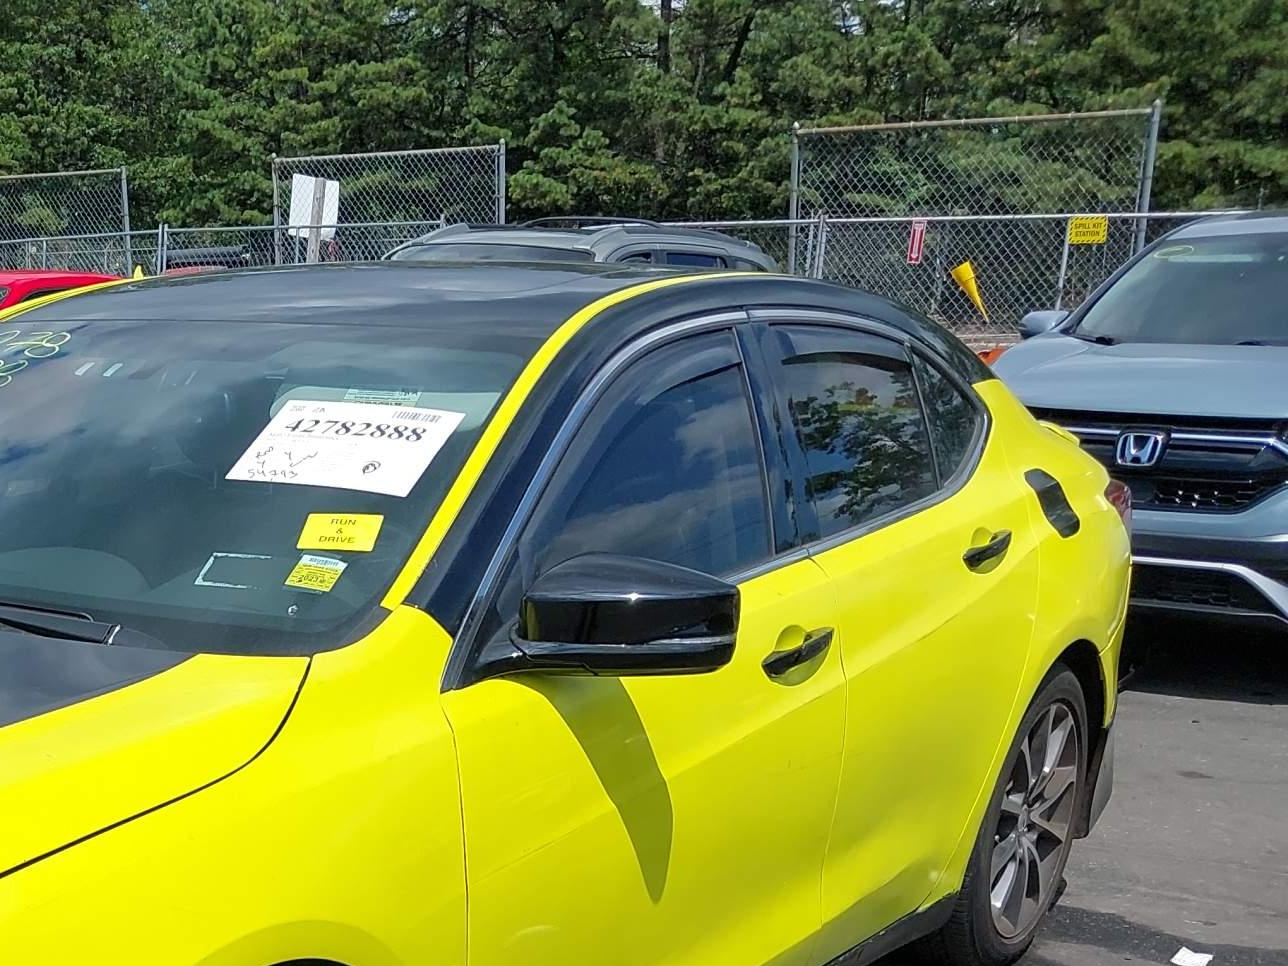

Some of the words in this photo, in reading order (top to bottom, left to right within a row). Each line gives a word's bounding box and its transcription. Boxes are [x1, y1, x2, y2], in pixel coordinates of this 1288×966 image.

[1074, 222, 1091, 230] SPILL
[1092, 222, 1103, 230] KIT
[1074, 230, 1100, 238] STATION
[285, 417, 427, 443] 42782888
[330, 518, 357, 526] RUN
[318, 535, 356, 544] DRIVE
